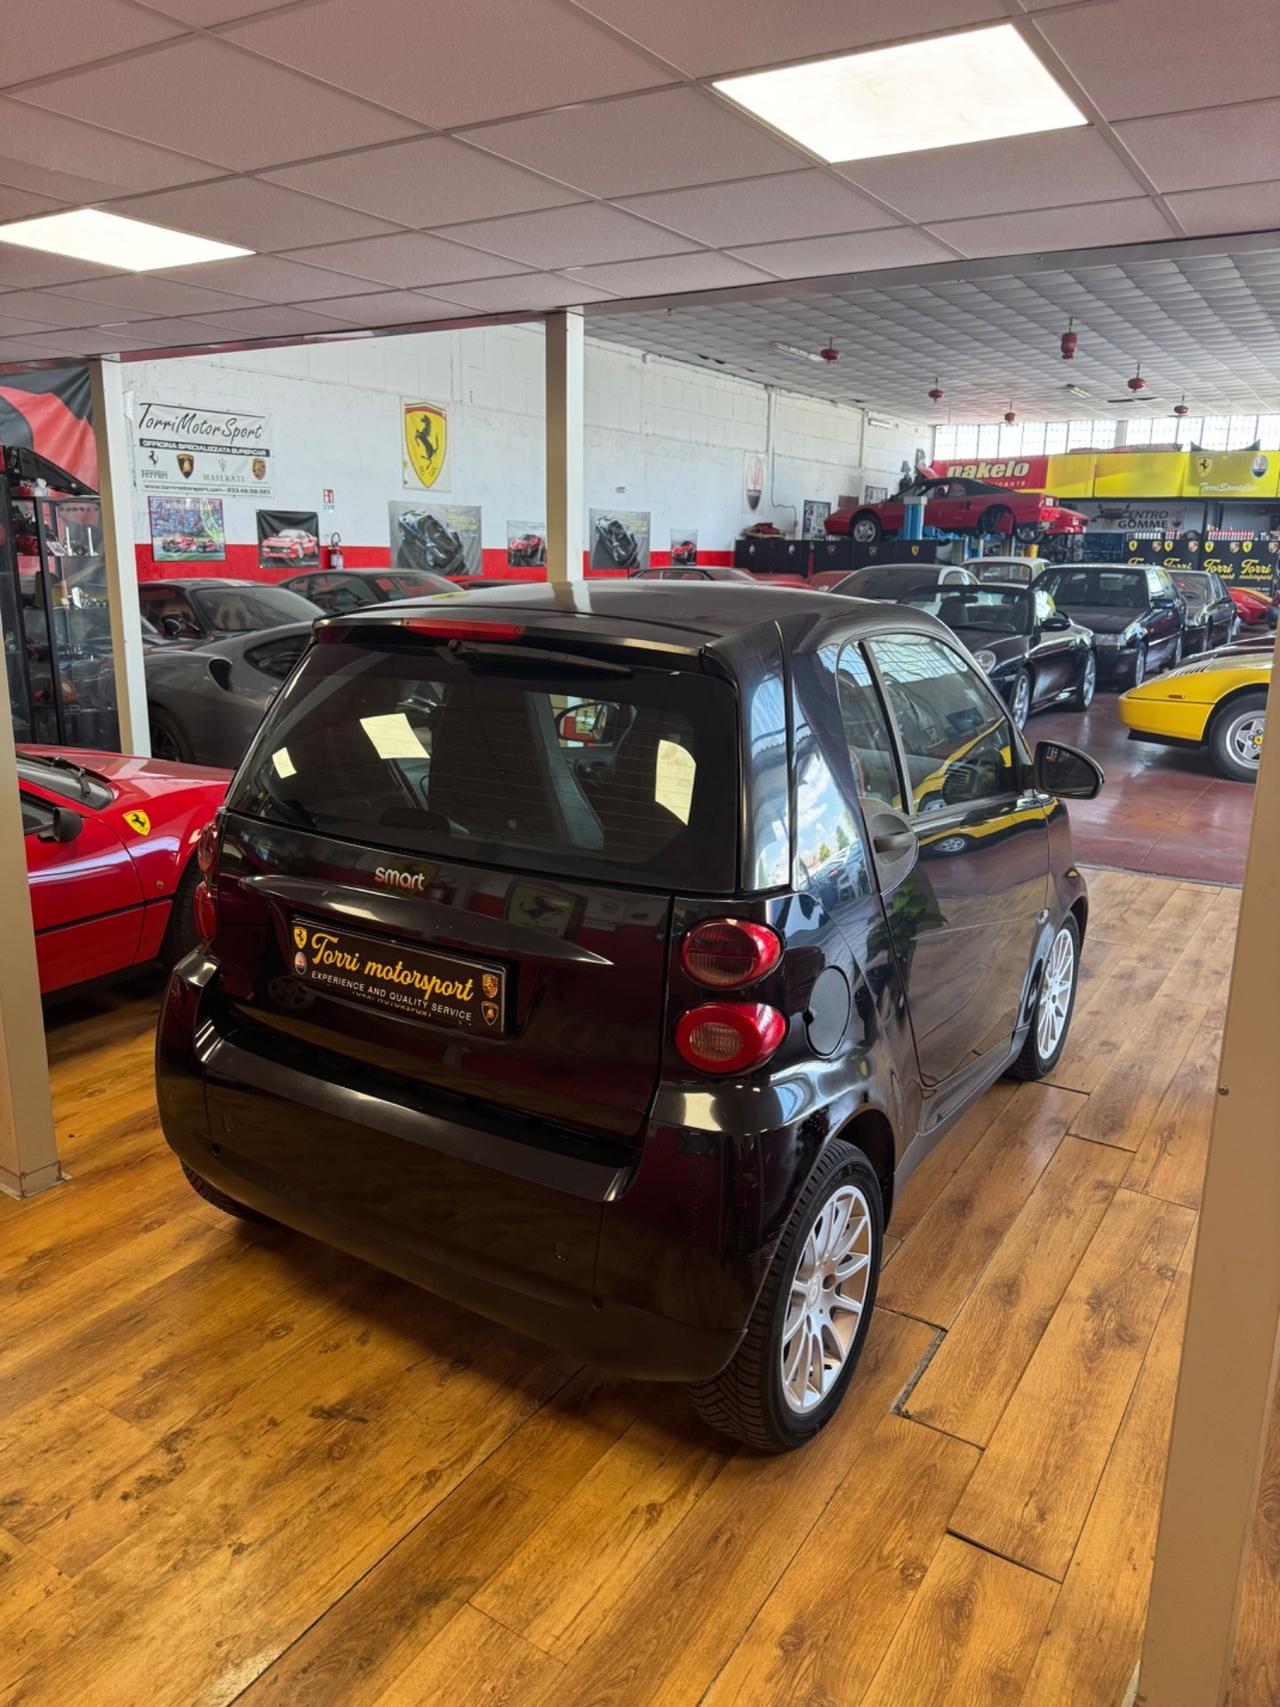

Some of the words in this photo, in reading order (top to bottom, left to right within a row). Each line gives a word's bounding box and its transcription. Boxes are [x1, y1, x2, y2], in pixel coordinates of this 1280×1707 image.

[139, 403, 265, 444] TorriMotorSport
[142, 440, 177, 449] OFFICINA
[178, 443, 231, 454] SPECIALIZZATA
[231, 447, 266, 456] SUPERCAR
[1118, 519, 1168, 529] GOMME
[1203, 558, 1233, 574] Torri
[1240, 558, 1272, 575] Torri
[374, 866, 425, 891] smart
[311, 932, 360, 972] Torri
[364, 961, 474, 1001] motorsport
[311, 970, 365, 993] EXPERIENCE
[367, 986, 387, 998] AND
[389, 991, 429, 1009] QUALITY
[431, 1002, 472, 1021] SERVICE
